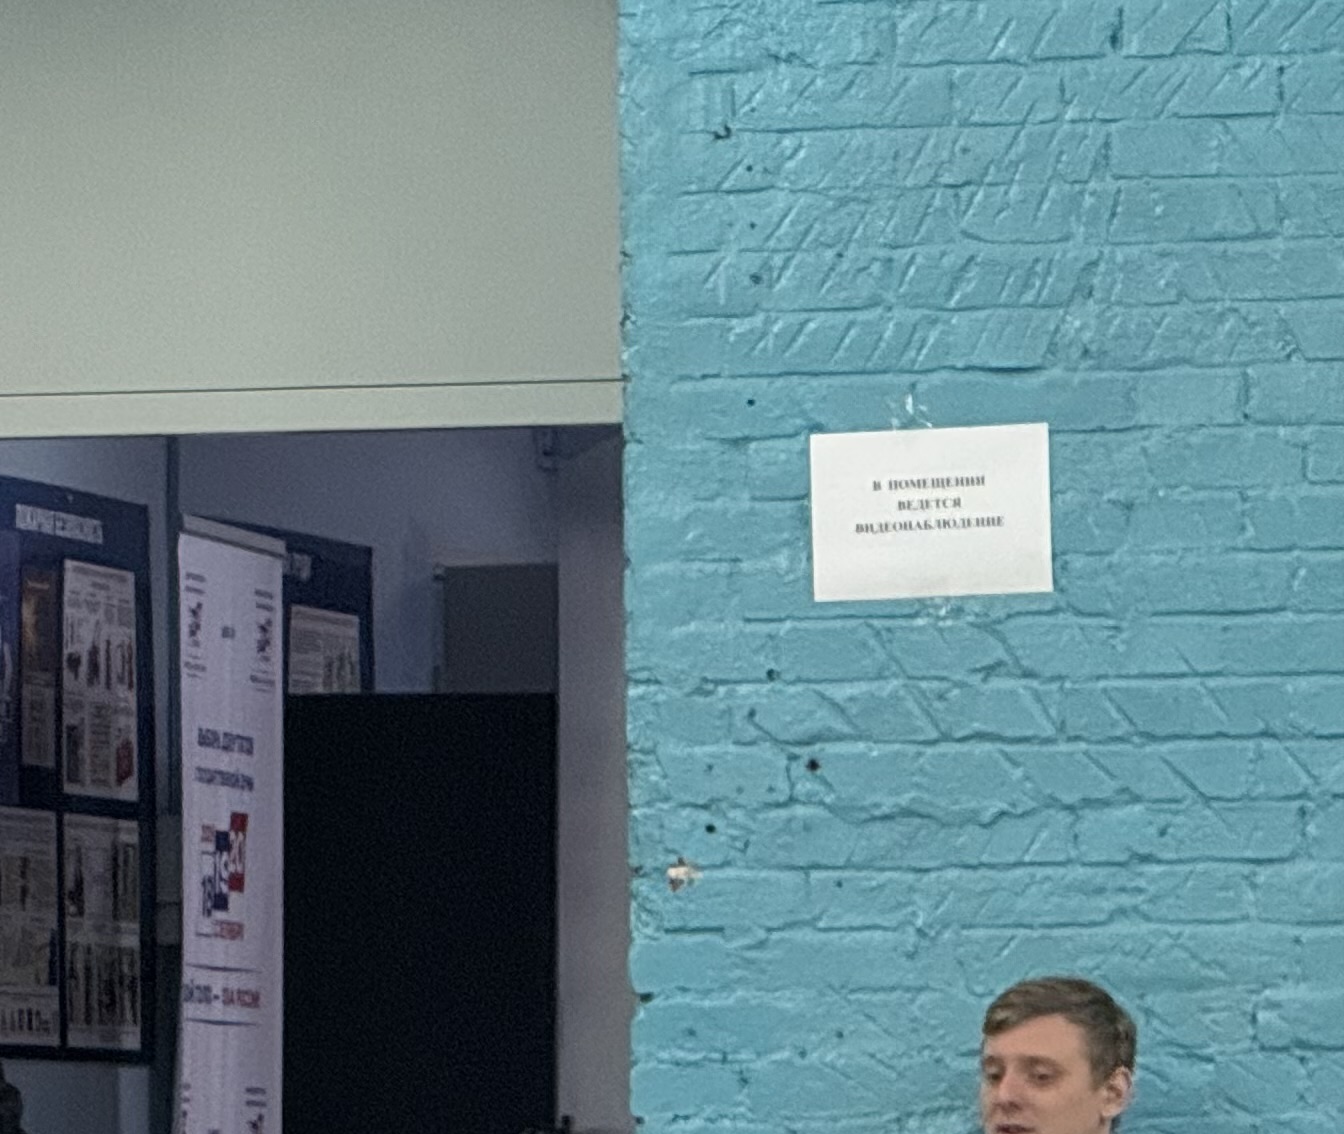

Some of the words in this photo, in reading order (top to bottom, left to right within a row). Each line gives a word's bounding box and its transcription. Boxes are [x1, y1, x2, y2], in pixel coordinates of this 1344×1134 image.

[872, 480, 882, 492] В
[888, 475, 986, 491] ПОМЕЩЕНИИ
[897, 497, 962, 512] ВЕДЕТСЯ
[854, 516, 1005, 534] ВИДЕОНАБЛЮДЕНИЕ
